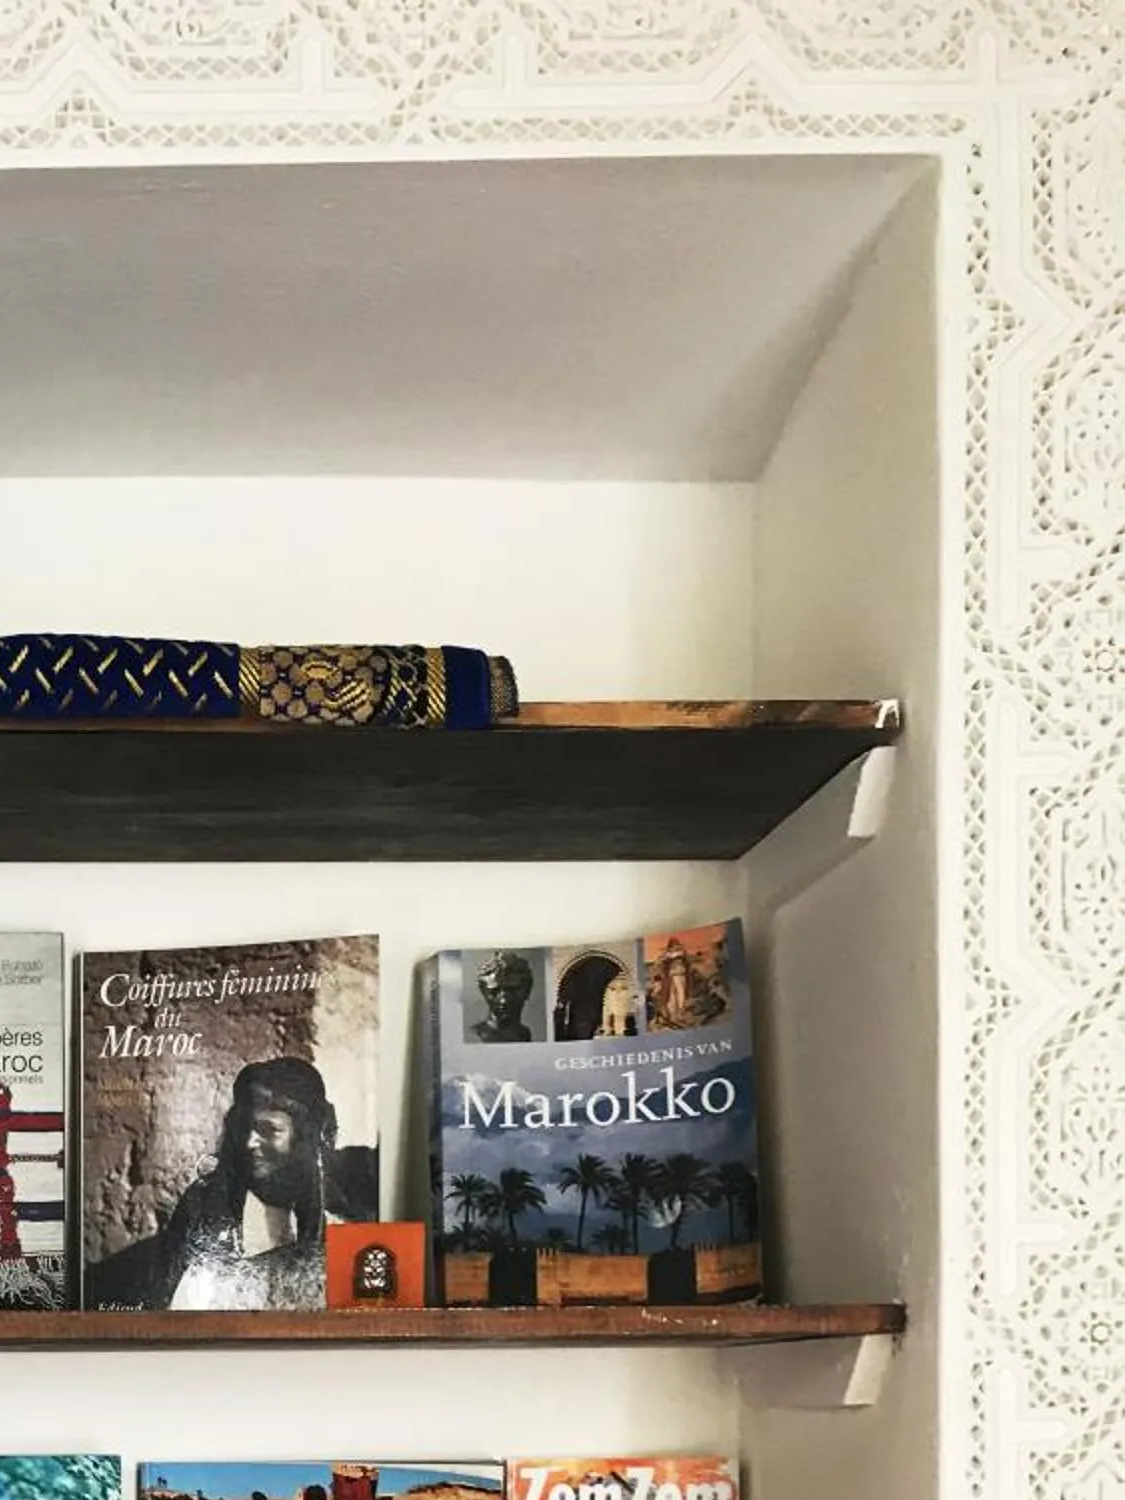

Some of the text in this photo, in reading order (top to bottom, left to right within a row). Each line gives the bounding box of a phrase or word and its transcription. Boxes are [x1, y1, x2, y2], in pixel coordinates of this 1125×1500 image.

[100, 972, 216, 1007] Coiffures
[154, 1008, 181, 1028] du
[98, 1025, 203, 1059] Maroc
[554, 1039, 733, 1071] GESCHIEDENIS VAN
[458, 1067, 736, 1131] Marokko
